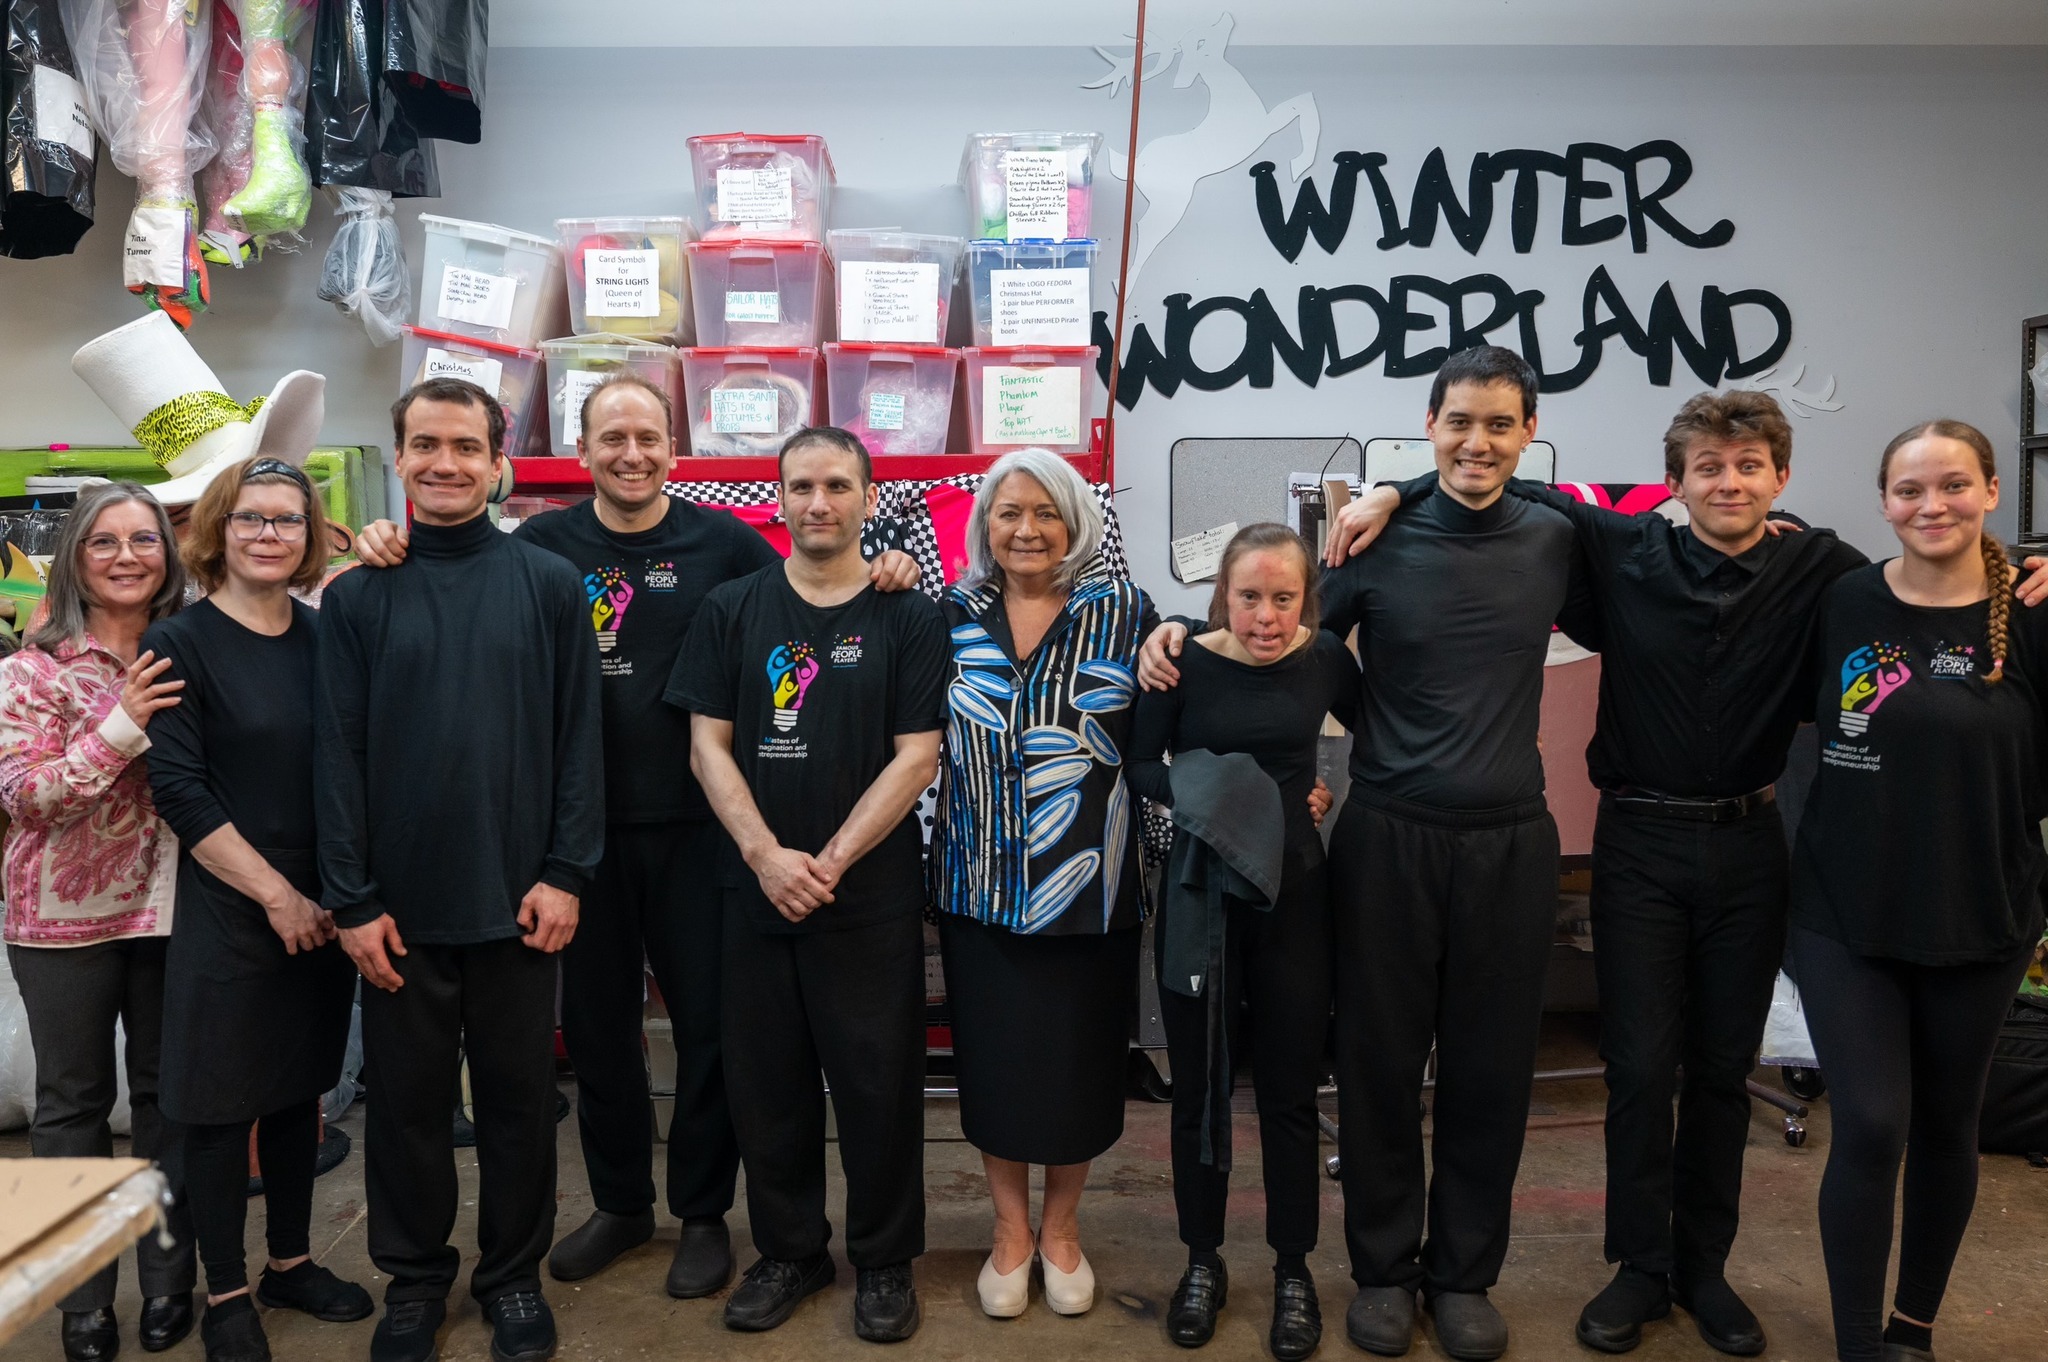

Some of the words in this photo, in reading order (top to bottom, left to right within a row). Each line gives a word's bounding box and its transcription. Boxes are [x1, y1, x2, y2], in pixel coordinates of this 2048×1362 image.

[1249, 140, 1735, 264] WINTER
[598, 255, 616, 263] Card
[618, 256, 646, 264] Symbols
[726, 292, 756, 304] SAILOR
[1091, 265, 1792, 412] WONDERLAND
[999, 375, 1044, 386] FANTASTIC
[714, 392, 745, 401] EXTRA
[748, 391, 777, 401] SANTA
[714, 402, 737, 413] HATS
[741, 403, 756, 412] FOR
[999, 402, 1024, 415] Player
[714, 413, 762, 423] COSTUMES
[716, 423, 740, 432] PROPS
[645, 576, 678, 584] PEOPLE
[831, 650, 862, 659] PEOPLE
[1936, 653, 1970, 663] FAMOUS
[1930, 659, 1974, 672] PEOPLE
[1829, 741, 1857, 753] Masters
[1862, 754, 1881, 763] and
